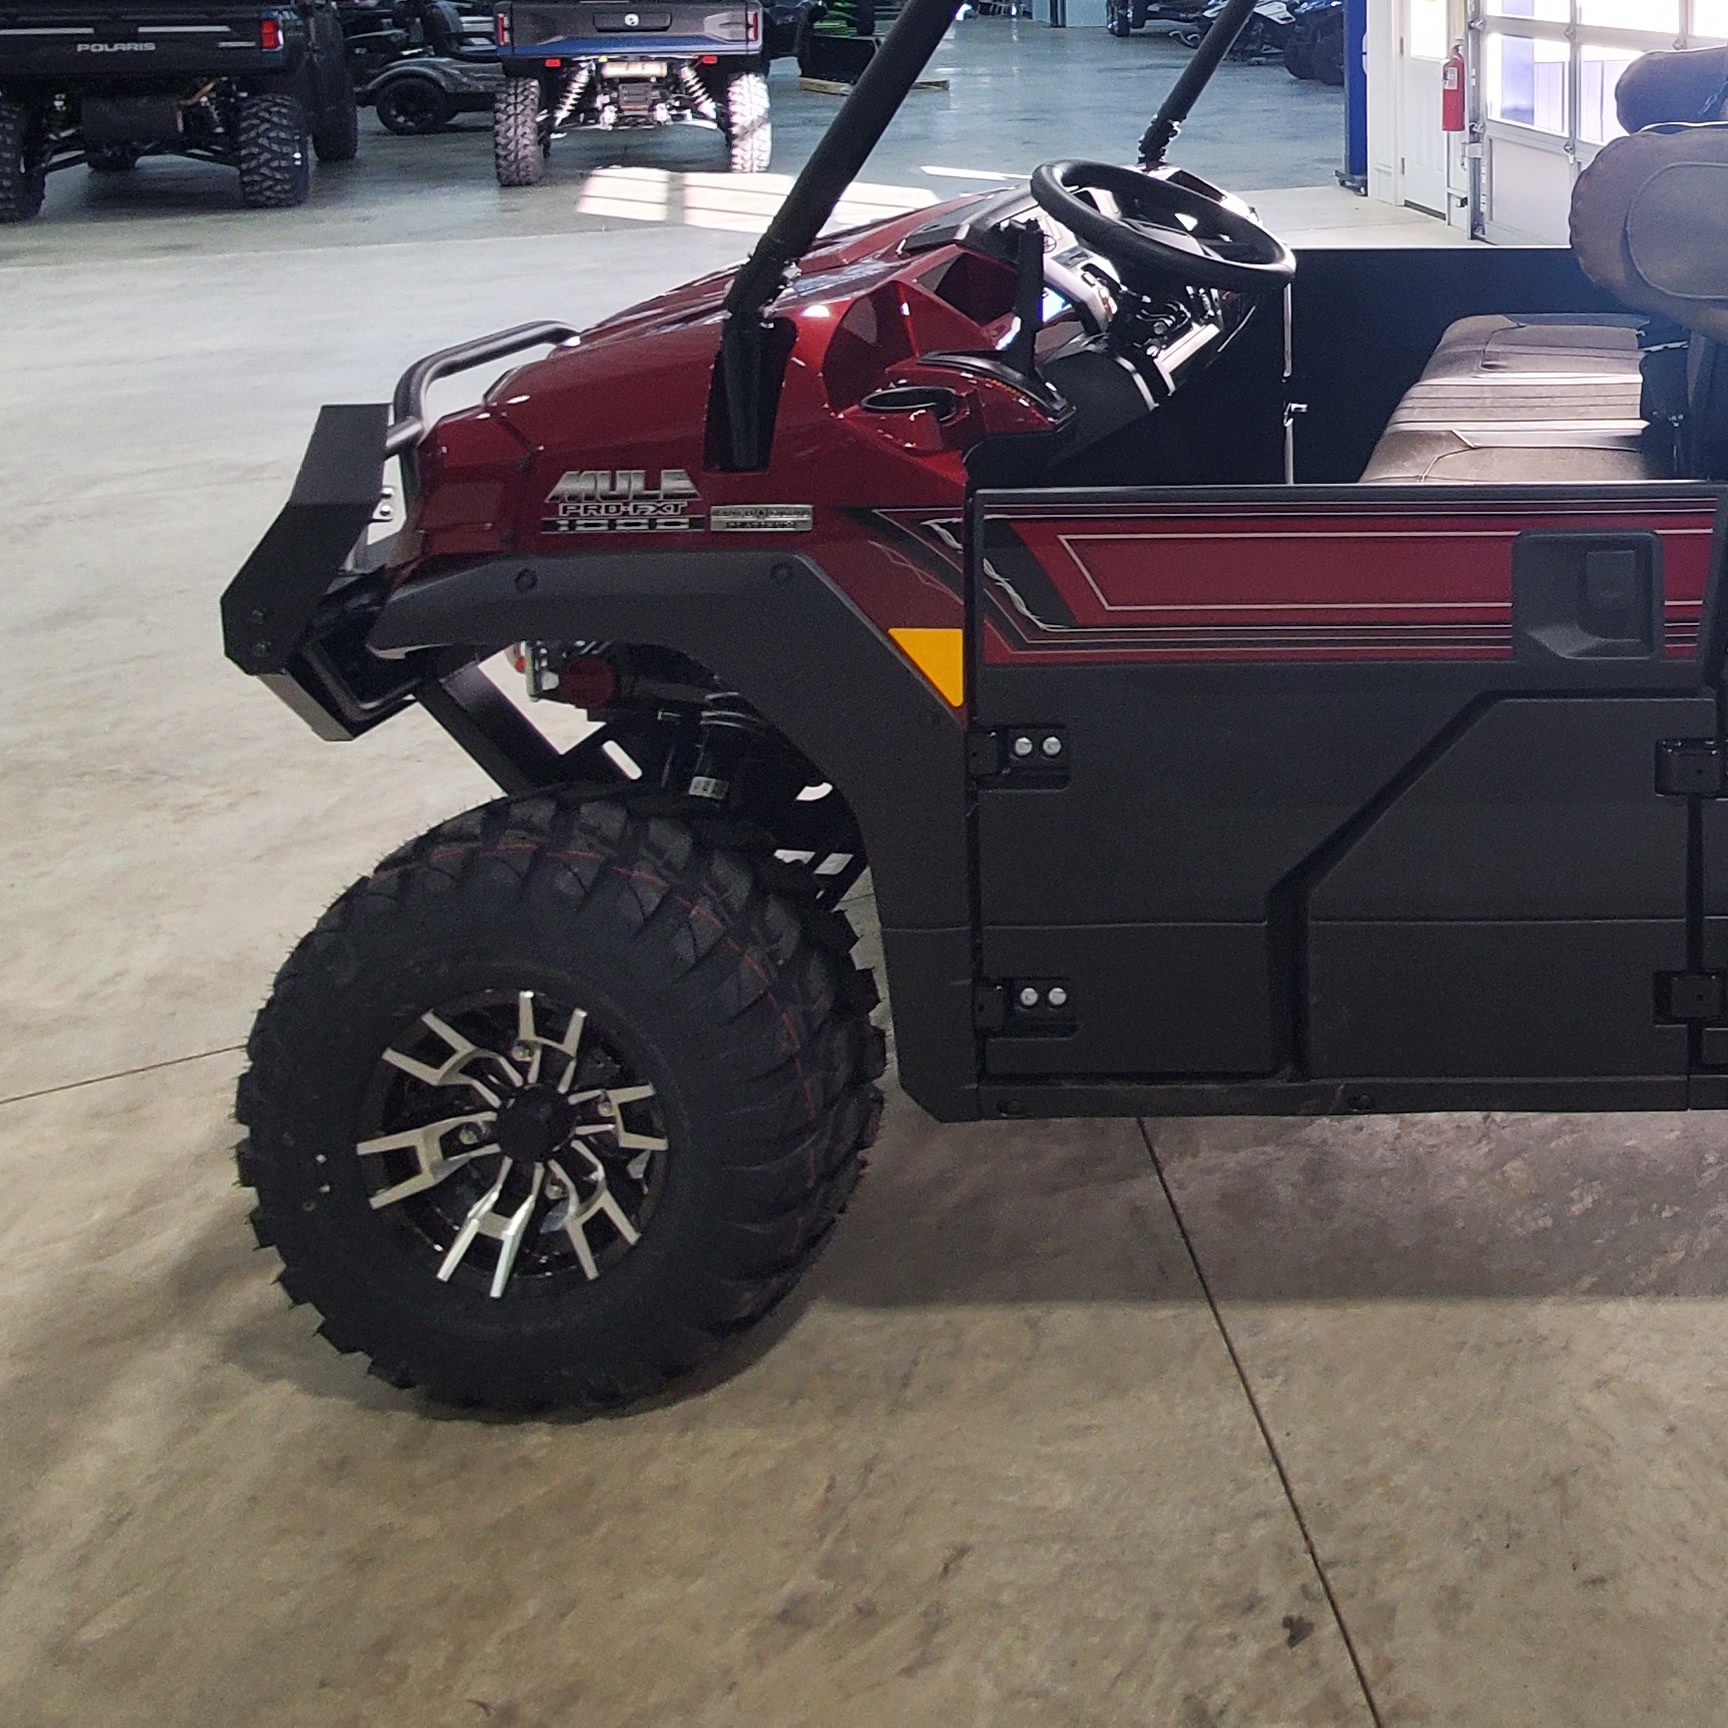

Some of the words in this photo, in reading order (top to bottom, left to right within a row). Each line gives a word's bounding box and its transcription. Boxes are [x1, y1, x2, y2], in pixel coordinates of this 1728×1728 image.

[77, 42, 156, 53] POLARIS
[544, 469, 703, 503] MULE
[555, 518, 691, 532] 1000
